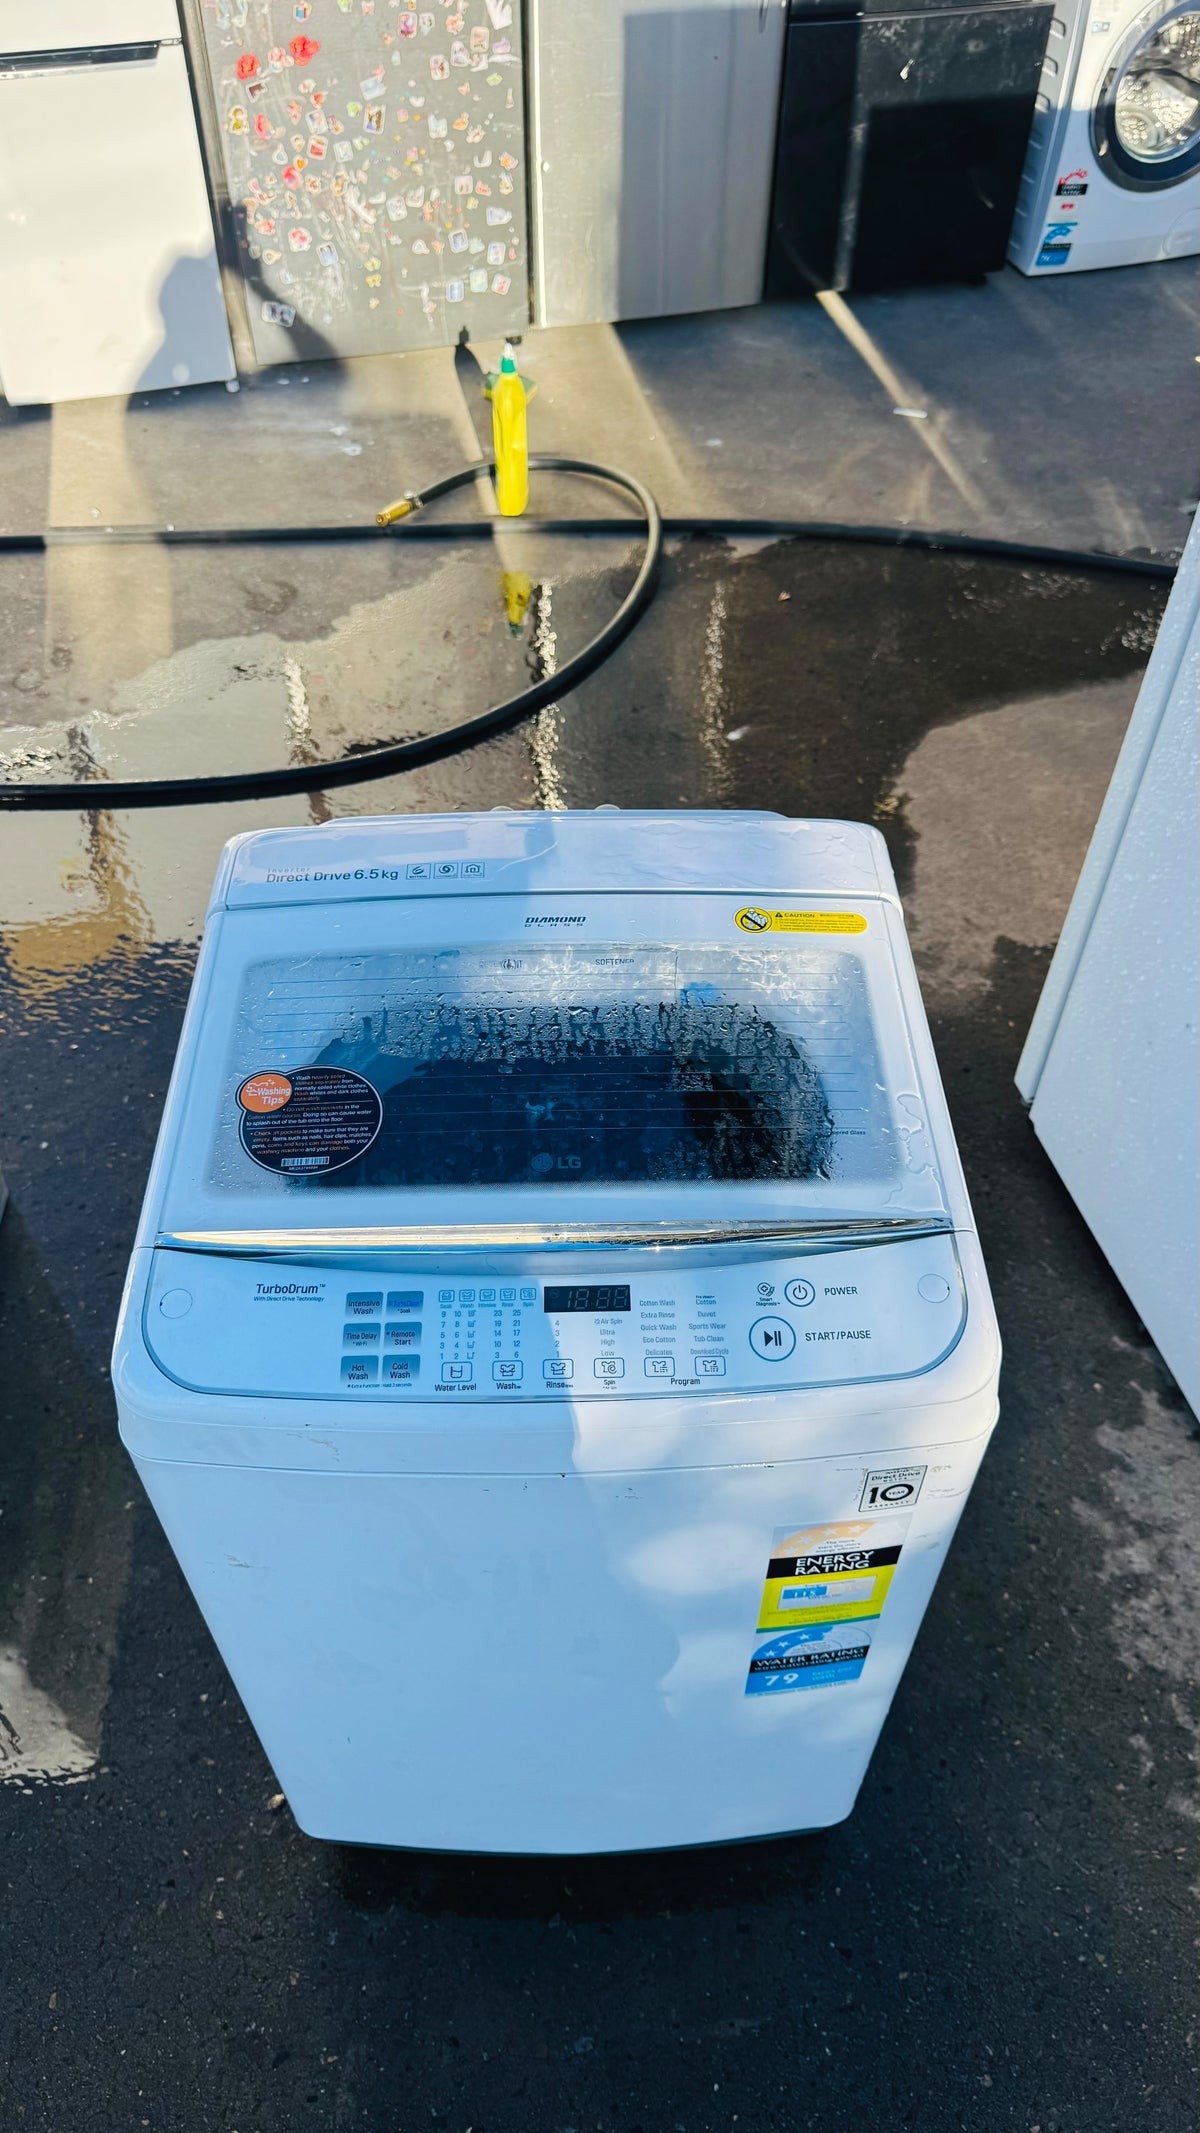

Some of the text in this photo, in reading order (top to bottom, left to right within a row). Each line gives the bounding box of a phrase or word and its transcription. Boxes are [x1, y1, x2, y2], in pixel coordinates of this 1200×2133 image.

[266, 873, 310, 883] Direct
[313, 872, 351, 880] Drive
[257, 1086, 291, 1096] Washing
[262, 1096, 284, 1105] Tips
[557, 1156, 582, 1168] LG
[824, 1286, 858, 1296] POWER
[353, 1307, 374, 1315] Wash
[493, 1309, 522, 1317] 23 25
[454, 1320, 460, 1328] 8
[512, 1319, 521, 1327] 21
[688, 1322, 709, 1331] Sports
[346, 1332, 377, 1341] Time Delay
[391, 1330, 416, 1338] Remote
[440, 1331, 445, 1339] 5
[494, 1329, 521, 1337] 14 17
[554, 1329, 560, 1337] 3
[805, 1329, 872, 1342] START/PAUSE
[394, 1338, 411, 1346] Start
[494, 1340, 502, 1348] 10
[554, 1340, 560, 1348] 2
[600, 1338, 616, 1346] High
[556, 1350, 560, 1358] 1
[645, 1348, 673, 1356] Delicates
[352, 1363, 365, 1372] Hot
[392, 1362, 409, 1370] Cold
[347, 1372, 369, 1380] Wash
[390, 1371, 411, 1379] Wash
[496, 1382, 516, 1390] Wash
[546, 1380, 566, 1389] Rinse
[670, 1377, 701, 1387] Program
[434, 1383, 477, 1392] Water Level
[871, 1473, 896, 1481] Direct
[869, 1483, 914, 1504] 10
[796, 1550, 875, 1567] ENERGY
[794, 1560, 870, 1575] RATING
[757, 1654, 806, 1667] WATER
[764, 1672, 799, 1686] 79
